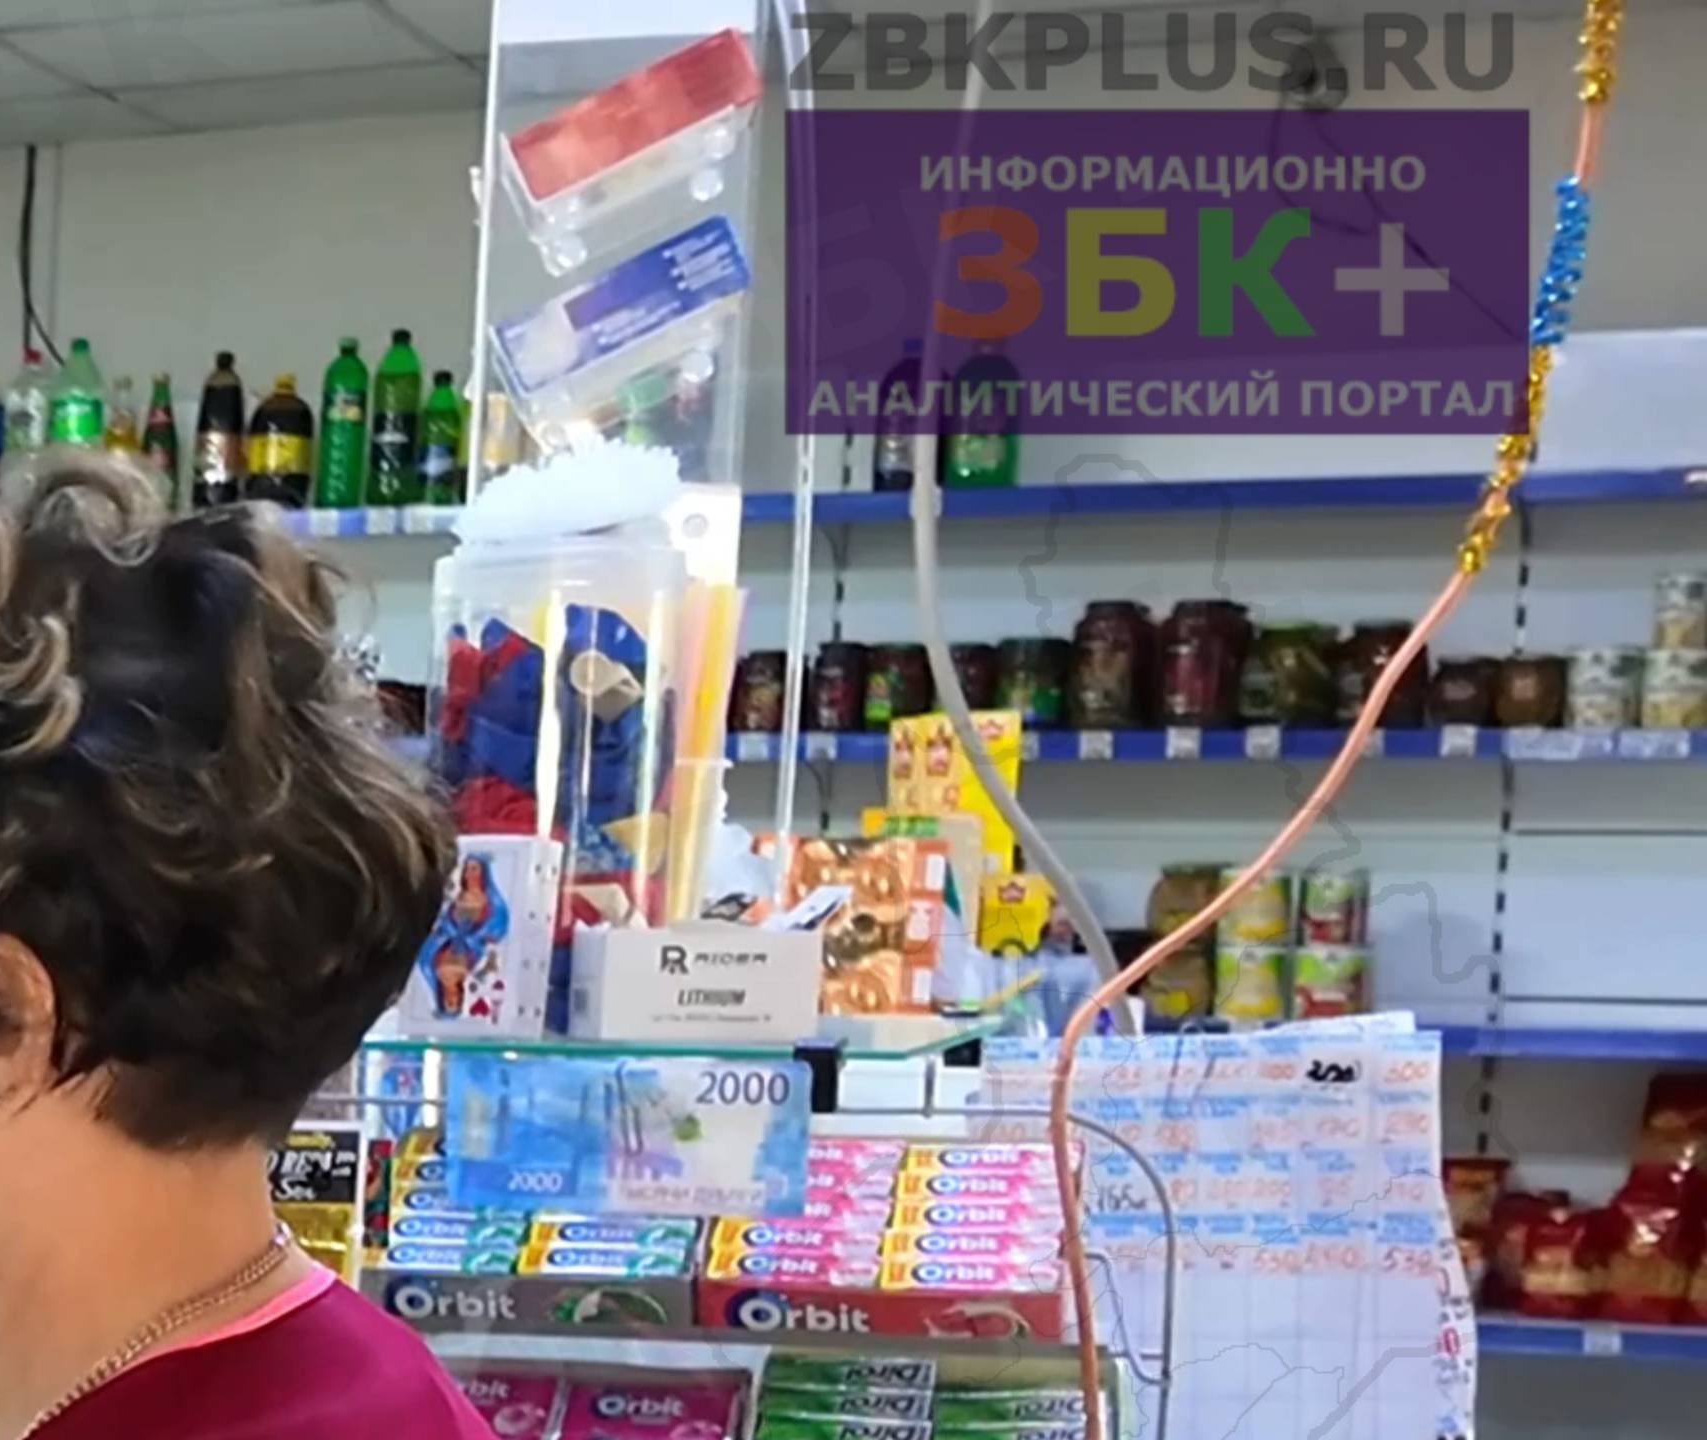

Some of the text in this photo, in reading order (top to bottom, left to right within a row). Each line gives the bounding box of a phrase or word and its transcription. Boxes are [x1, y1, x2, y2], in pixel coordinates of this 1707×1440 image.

[696, 1071, 791, 1106] 2000
[941, 1148, 1021, 1167] Orbit
[508, 1171, 564, 1193] 2000
[929, 1176, 1008, 1195] Orbit
[928, 1206, 1007, 1224] Orbit
[395, 1216, 465, 1237] Orbit
[561, 1223, 634, 1242] Orbit
[745, 1226, 822, 1247] Orbit
[391, 1244, 462, 1264] Orbit
[917, 1233, 998, 1254] Orbit
[551, 1248, 625, 1268] Orbit
[741, 1254, 818, 1275] Orbit
[915, 1262, 995, 1283] Orbit
[395, 1284, 516, 1320] Orbit
[740, 1298, 870, 1333] Orbit
[460, 1380, 510, 1399] rbit
[597, 1393, 685, 1418] Orbit
